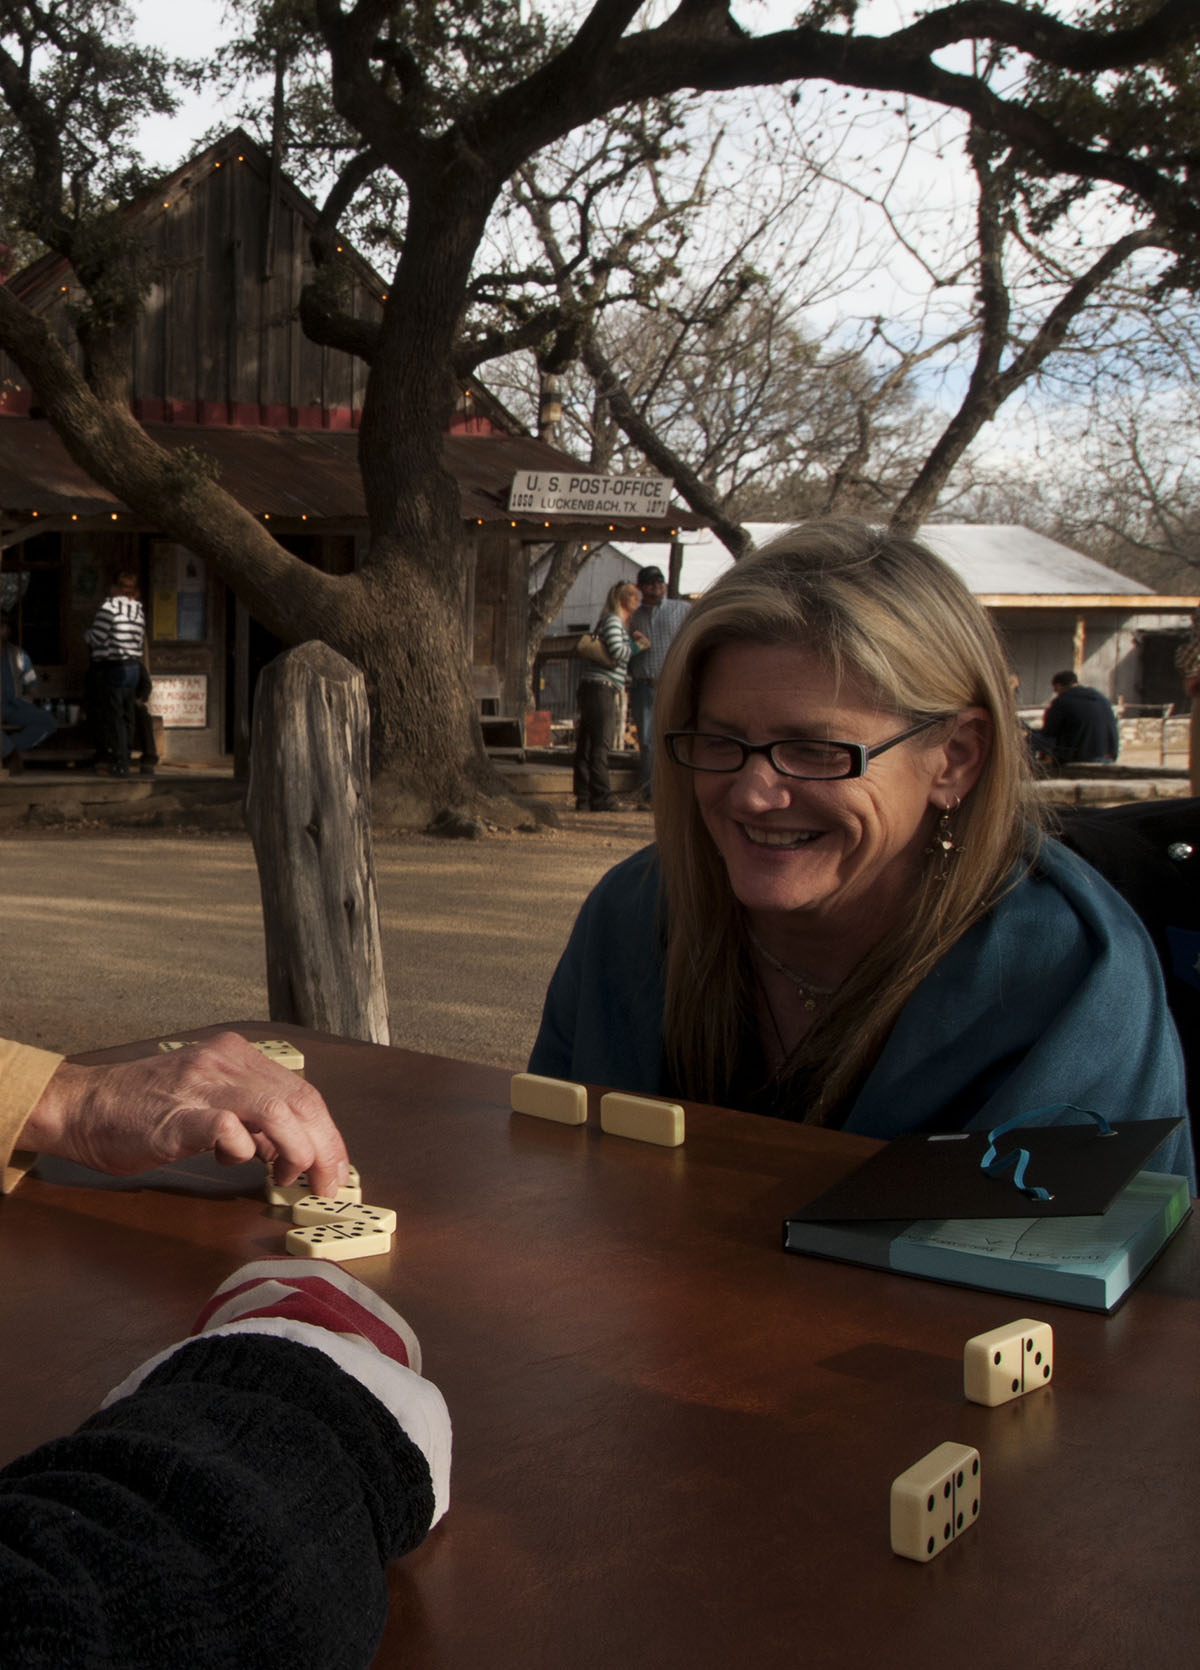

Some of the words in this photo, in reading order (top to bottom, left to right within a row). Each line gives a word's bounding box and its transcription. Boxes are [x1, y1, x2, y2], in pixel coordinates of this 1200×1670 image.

[527, 474, 541, 492] U.
[548, 476, 562, 493] S.
[569, 477, 663, 498] POST-OFFICE
[541, 497, 621, 513] LUCKENBACH,
